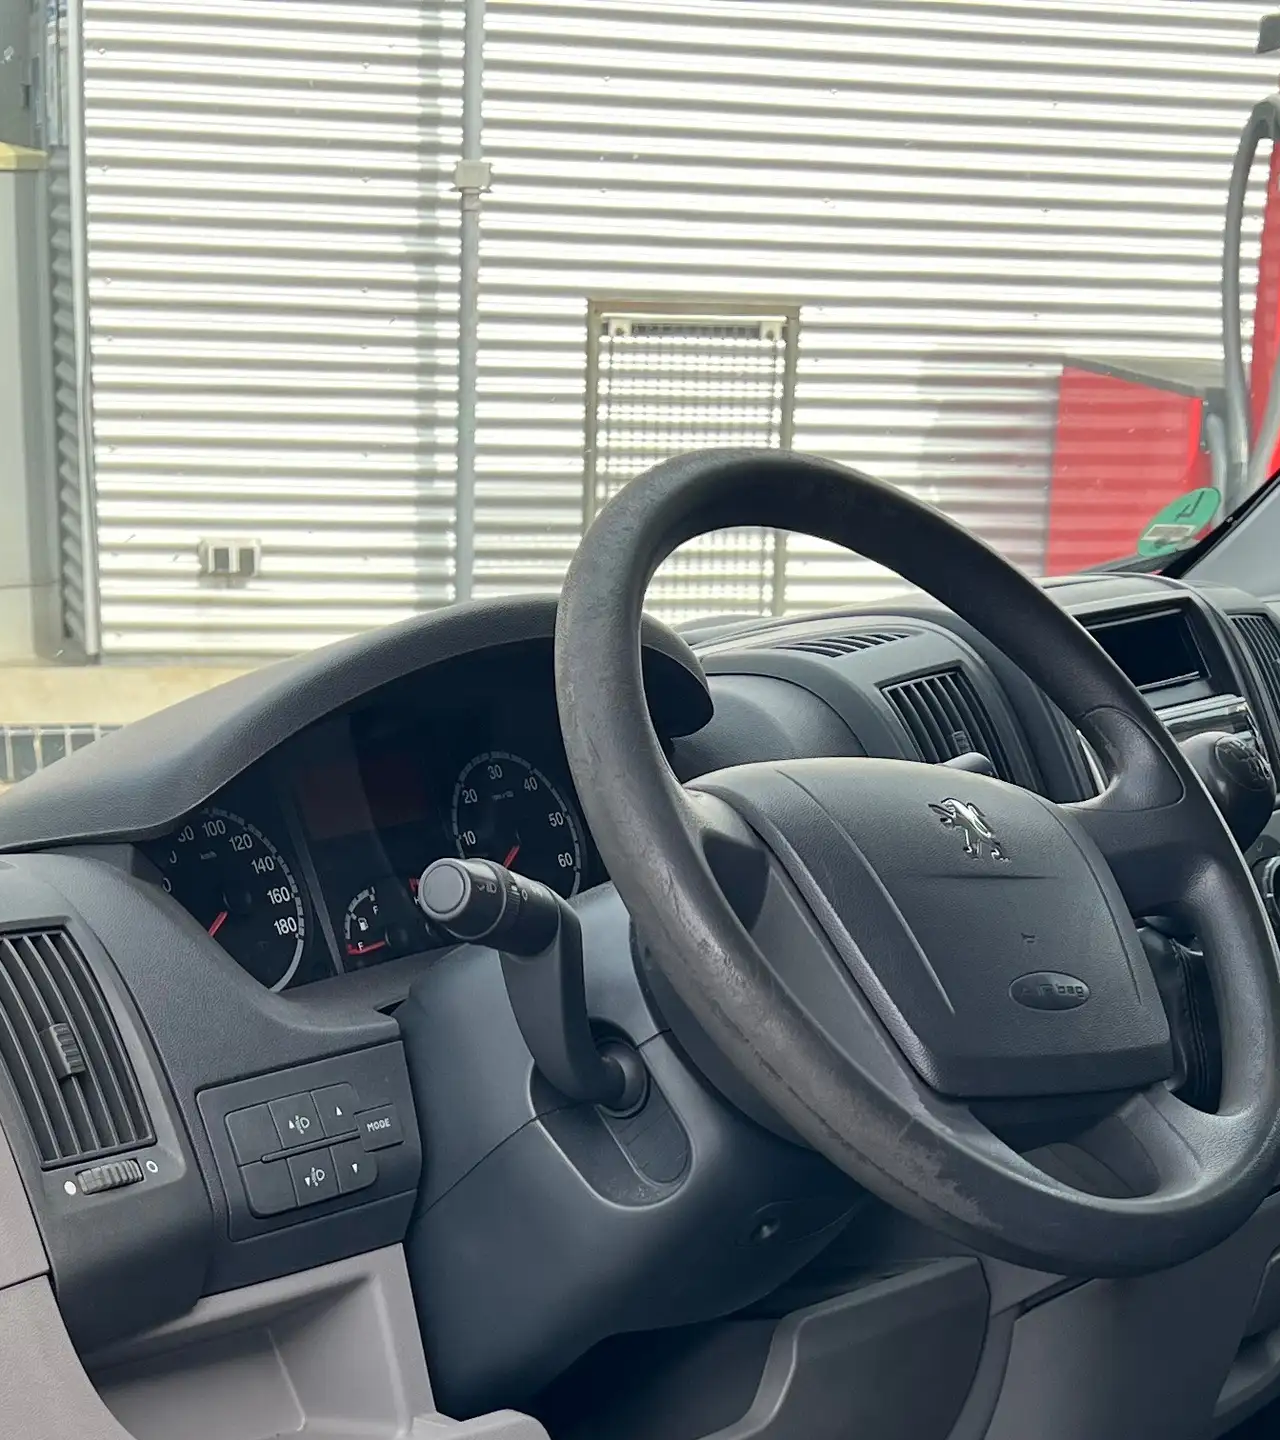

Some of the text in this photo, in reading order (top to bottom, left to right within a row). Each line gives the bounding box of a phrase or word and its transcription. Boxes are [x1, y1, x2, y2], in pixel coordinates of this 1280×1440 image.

[487, 764, 503, 780] 30
[523, 776, 538, 792] 40
[462, 788, 478, 804] 20
[548, 811, 564, 827] 50
[202, 819, 227, 838] 100
[228, 833, 253, 852] 120
[462, 830, 476, 846] 10
[251, 856, 275, 874] 140
[557, 852, 573, 868] 60
[266, 886, 290, 905] 160
[273, 916, 297, 936] 180
[366, 1117, 392, 1133] MODE
